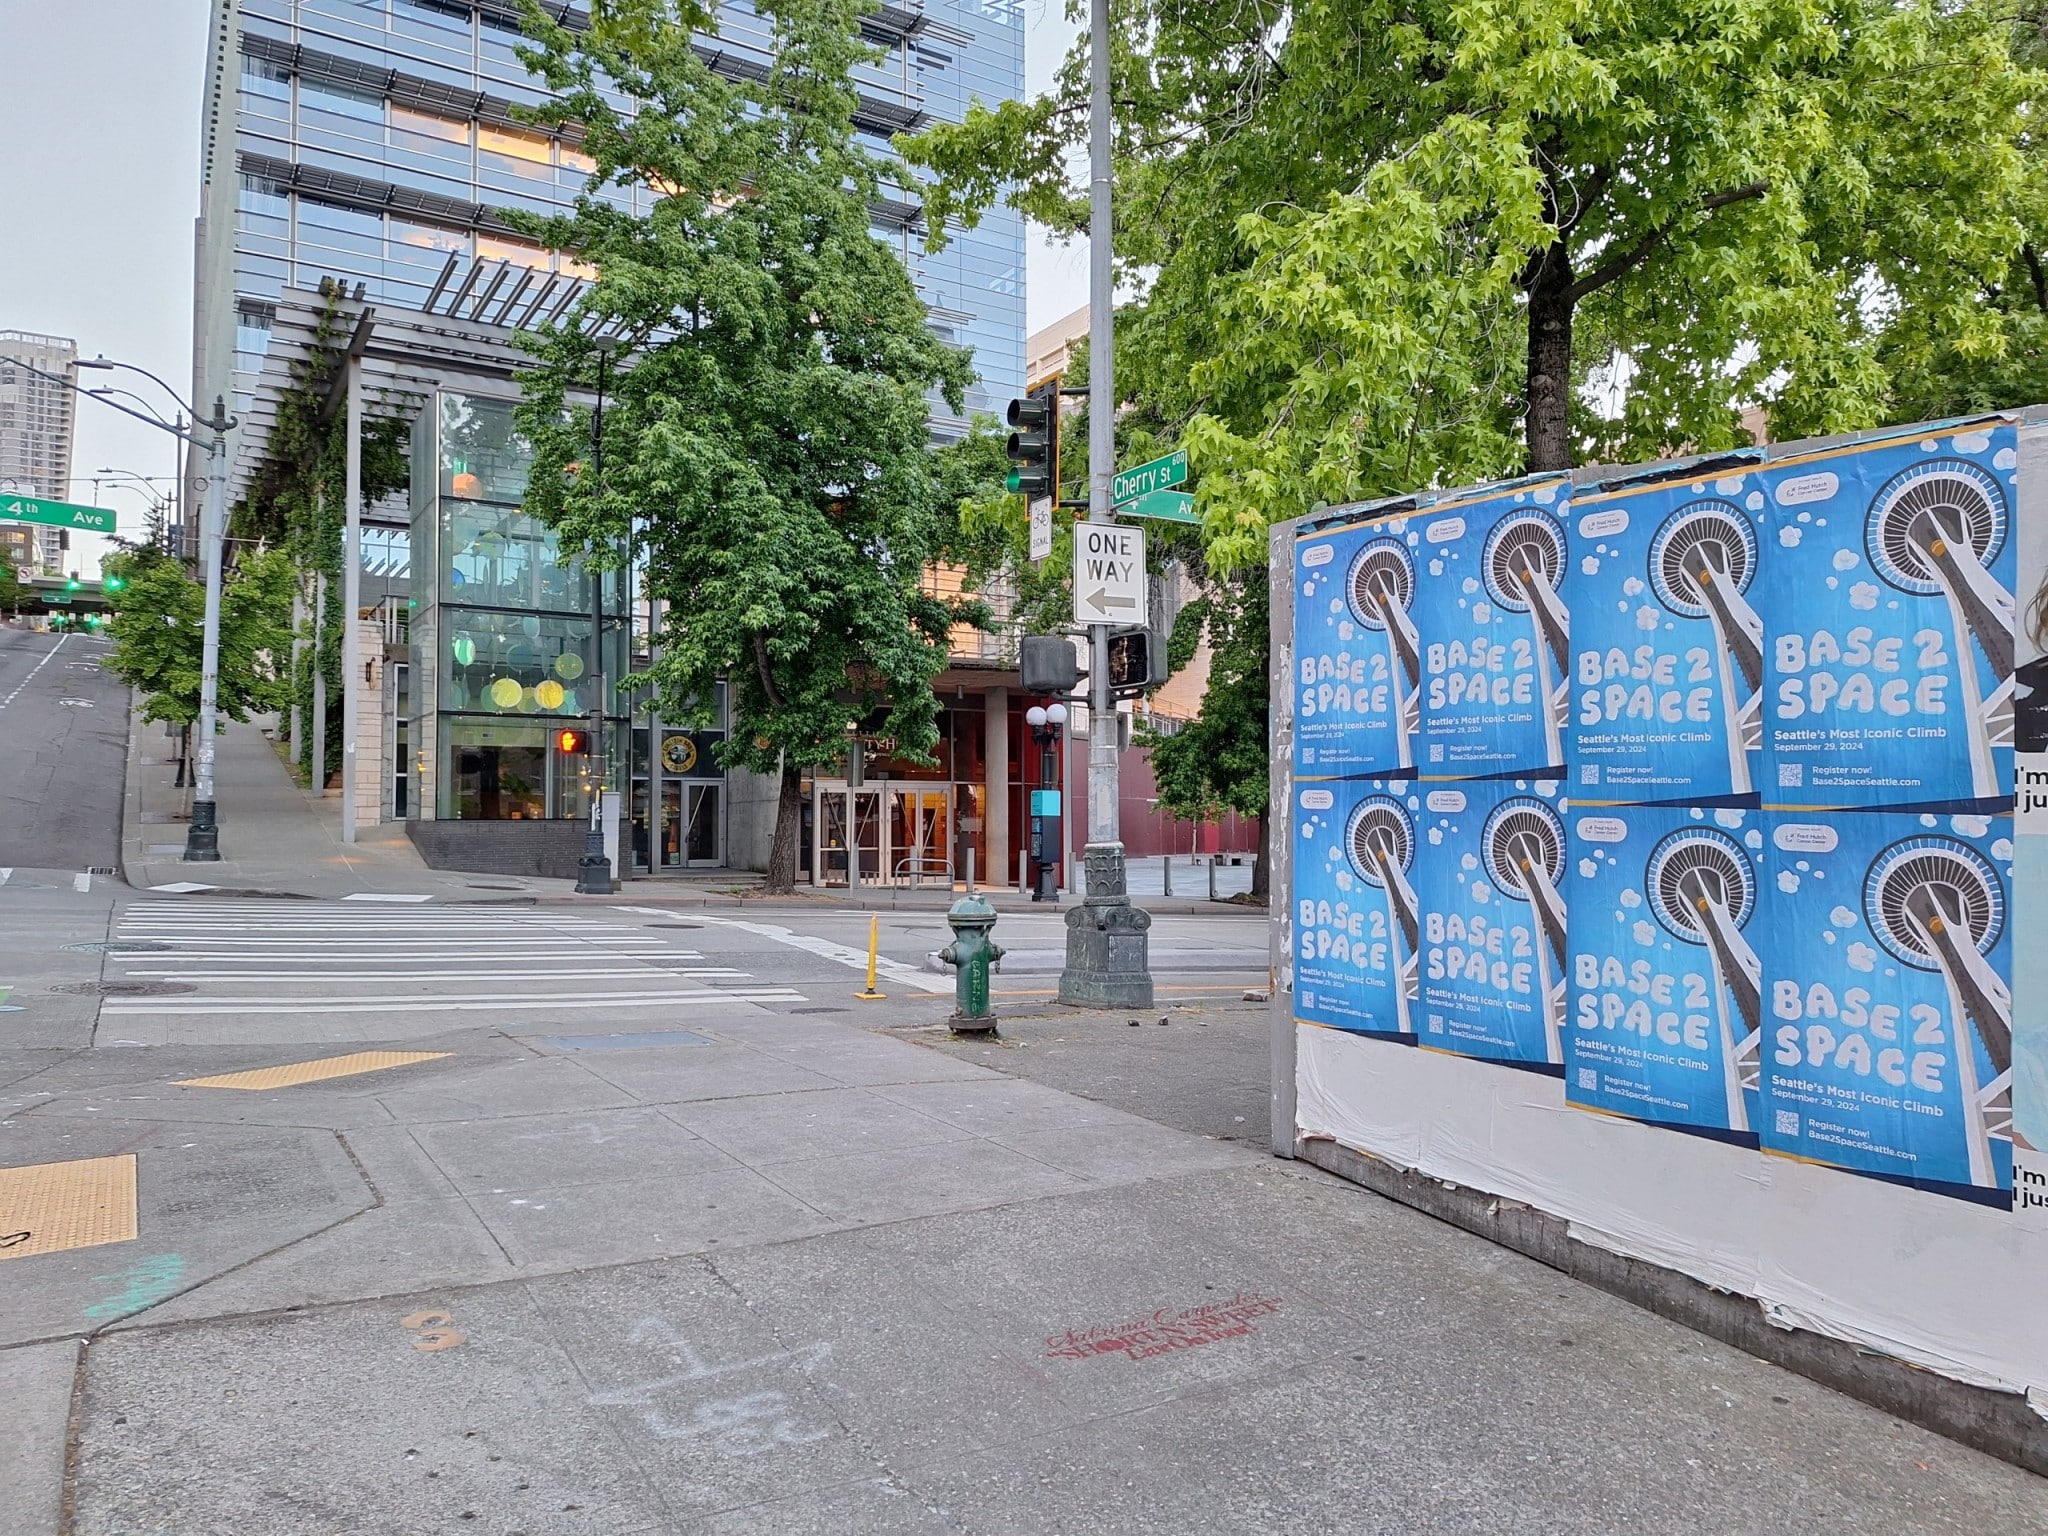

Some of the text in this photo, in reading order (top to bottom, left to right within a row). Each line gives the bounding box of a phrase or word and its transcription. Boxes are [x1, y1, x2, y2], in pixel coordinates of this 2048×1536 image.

[1172, 452, 1185, 466] 600
[1115, 466, 1171, 500] Cherry St
[7, 501, 104, 525] 4th Ave
[1088, 532, 1132, 556] ONE
[1086, 559, 1134, 583] WAY
[1427, 636, 1533, 674] BASE 2
[1775, 626, 1949, 674] BASE 2
[1302, 652, 1388, 685] BASE 2
[1578, 644, 1712, 686] BASE 2
[1302, 683, 1388, 717] SPACE
[1428, 672, 1534, 710] SPACE
[1776, 672, 1949, 720] SPACE
[1580, 684, 1713, 726] SPACE
[1300, 724, 1327, 732] Seattle's
[1329, 722, 1343, 730] Most
[1367, 720, 1387, 729] Climb
[1427, 713, 1532, 726] Seattle's Most Iconic Climb
[1578, 732, 1712, 744] Seattle's Most Iconic Climb
[1774, 727, 1946, 741] Seattle's Most Iconic Climb
[1578, 746, 1614, 754] September
[1774, 742, 1864, 752] September 29, 2024
[1607, 766, 1635, 775] Register
[1812, 766, 1873, 775] Register now!
[1812, 778, 1921, 787] Base2SpaceSeattle.com
[1300, 900, 1387, 939] BASE 2
[1426, 912, 1532, 957] BASE 2
[1301, 929, 1387, 971] SPACE
[1300, 966, 1386, 987] Seattle's Most Iconic Climb
[1428, 946, 1532, 994] SPACE
[1575, 954, 1710, 1009] BASE 2
[1426, 987, 1531, 1011] Seattle's Most Iconic Climb
[1426, 998, 1454, 1009] September
[1466, 1004, 1480, 1012] 2024
[1576, 992, 1710, 1051] SPACE
[1772, 980, 1945, 1045] BASE 2
[1575, 1037, 1709, 1071] Seattle's Most Iconic Climb
[1575, 1049, 1643, 1069] September 29, 2024
[1774, 1024, 1946, 1094] SPACE
[1604, 1075, 1651, 1091] Register now!
[1772, 1075, 1944, 1117] Seattle's Most Iconic Climb
[1772, 1088, 1860, 1112] September 29, 2024
[1809, 1118, 1870, 1139] Register now!
[1809, 1129, 1917, 1161] Base2SpaceSeattle.com
[2013, 1164, 2046, 1186] I'm
